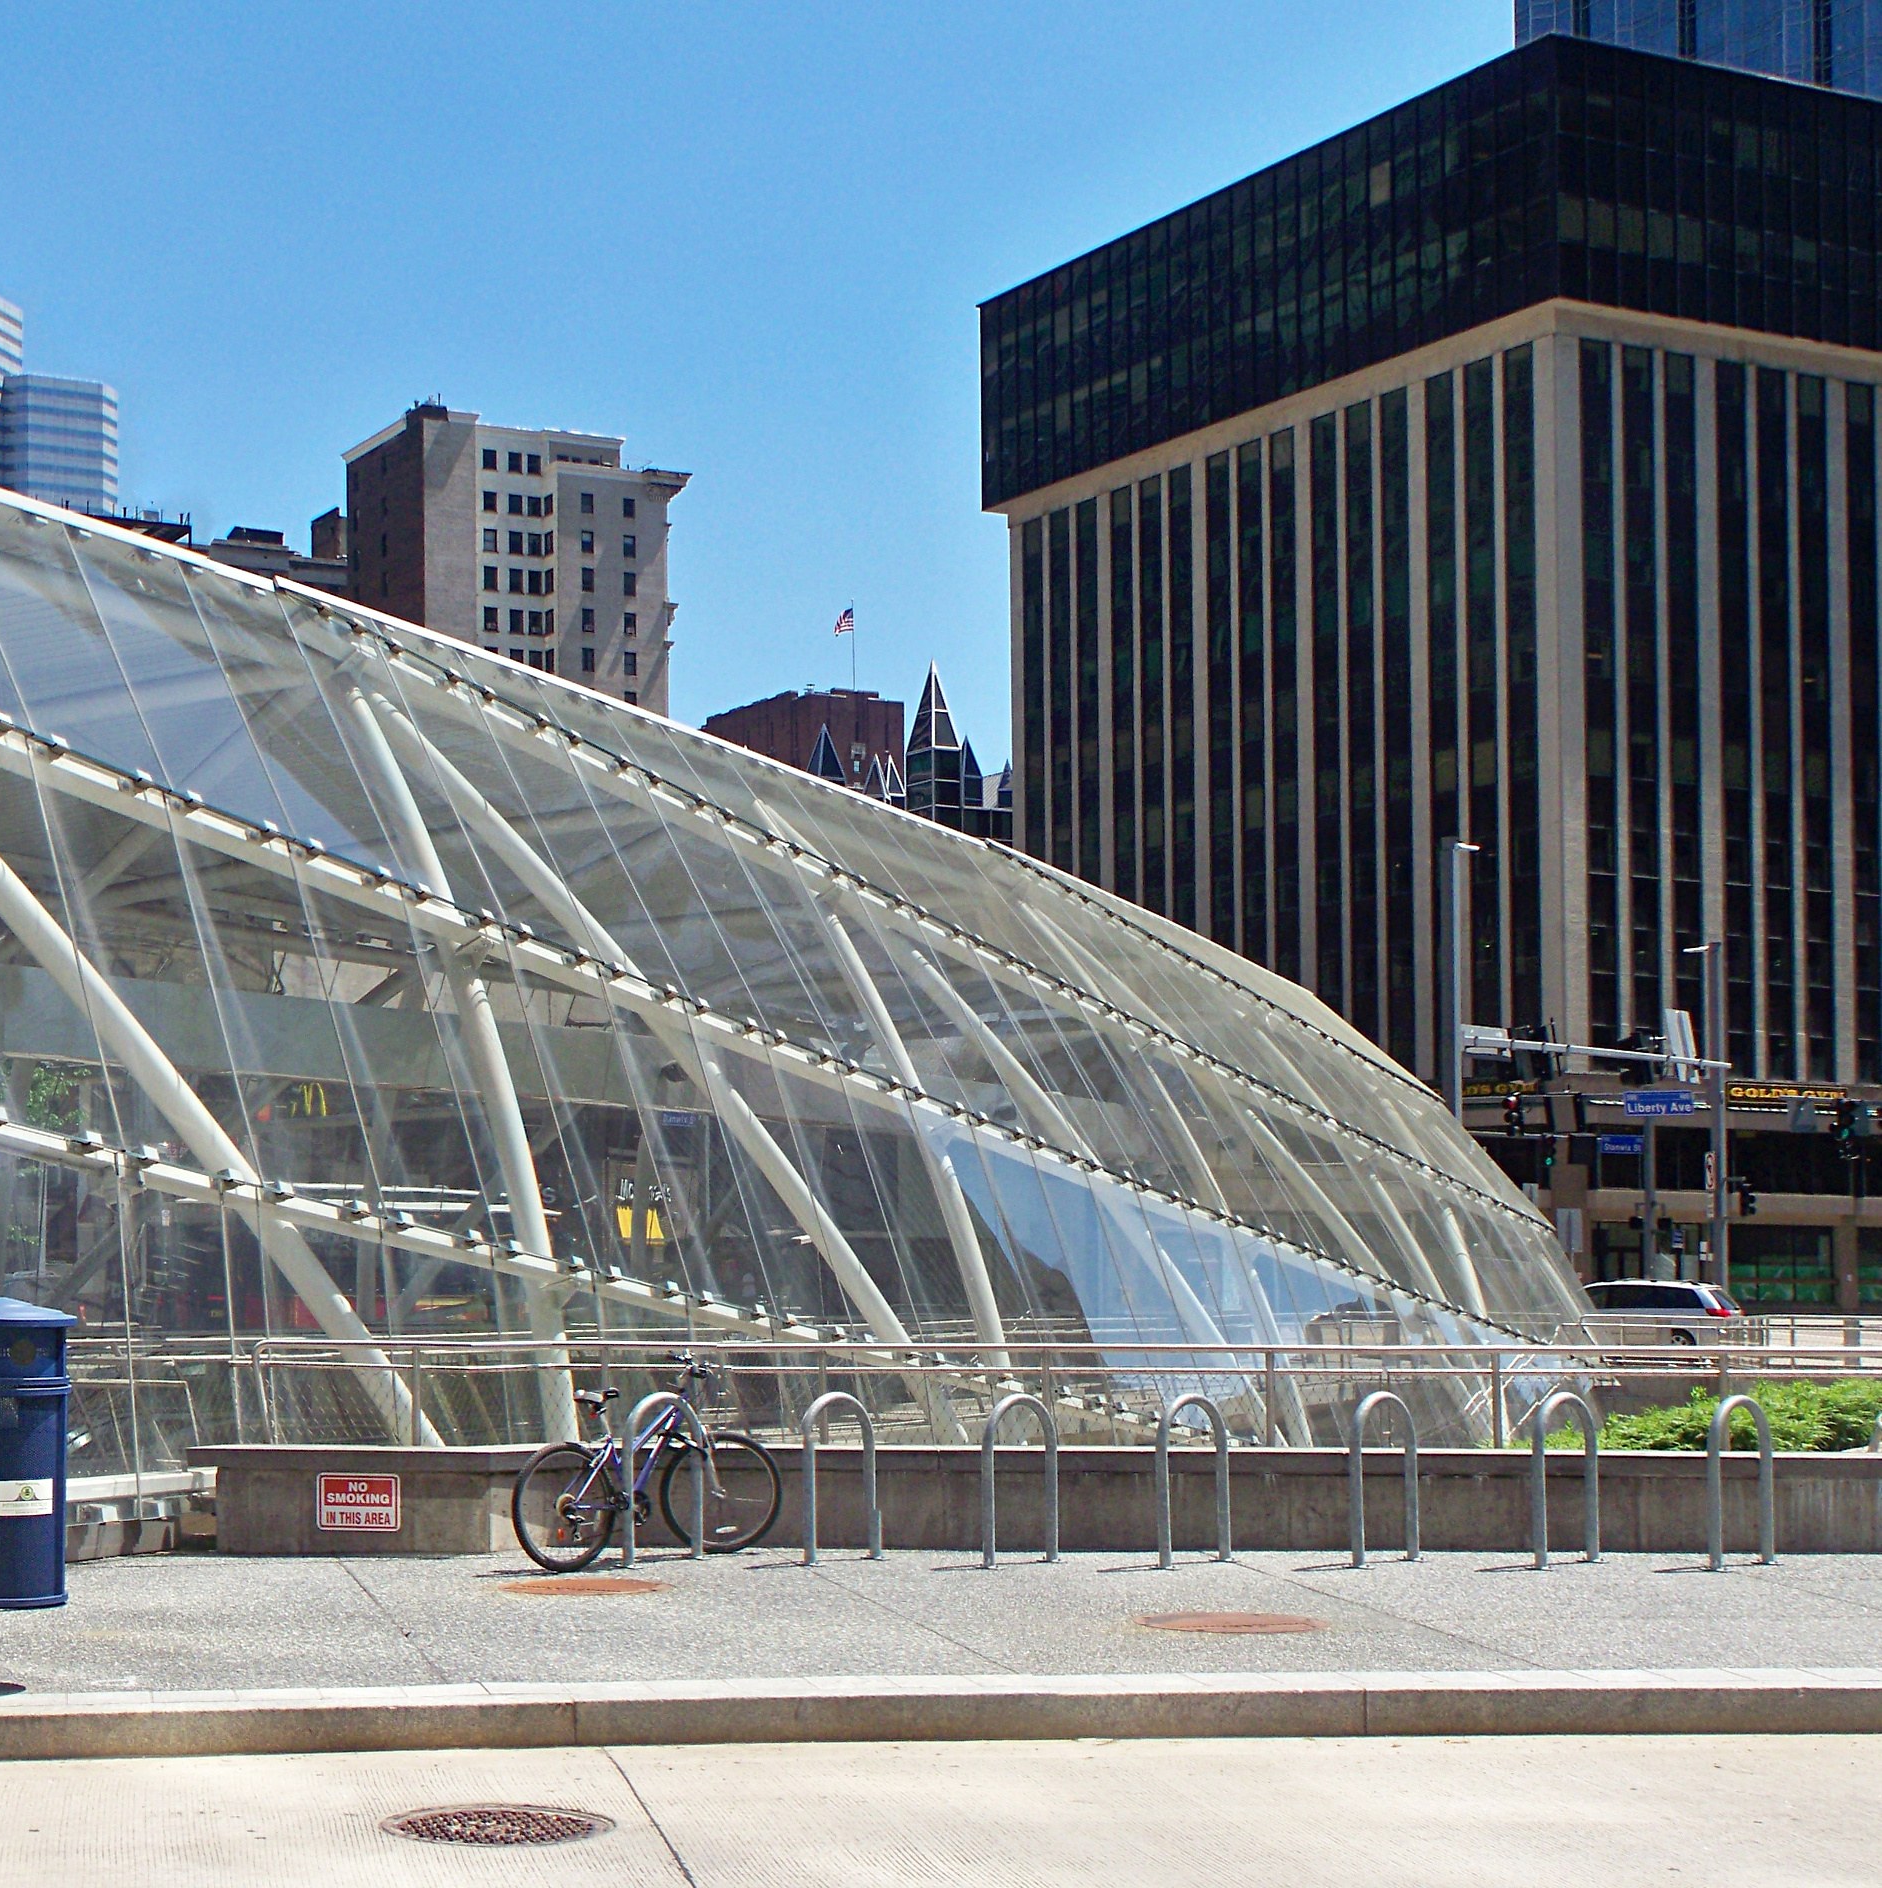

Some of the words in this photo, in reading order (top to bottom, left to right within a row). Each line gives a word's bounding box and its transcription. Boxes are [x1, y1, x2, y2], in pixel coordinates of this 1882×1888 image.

[1627, 1102, 1667, 1114] Liberty
[1670, 1101, 1693, 1113] Ave
[348, 1482, 368, 1492] NO
[326, 1493, 390, 1504] SMOKING
[326, 1512, 336, 1524] IN
[339, 1512, 361, 1525] THIS
[364, 1512, 391, 1525] AREA
